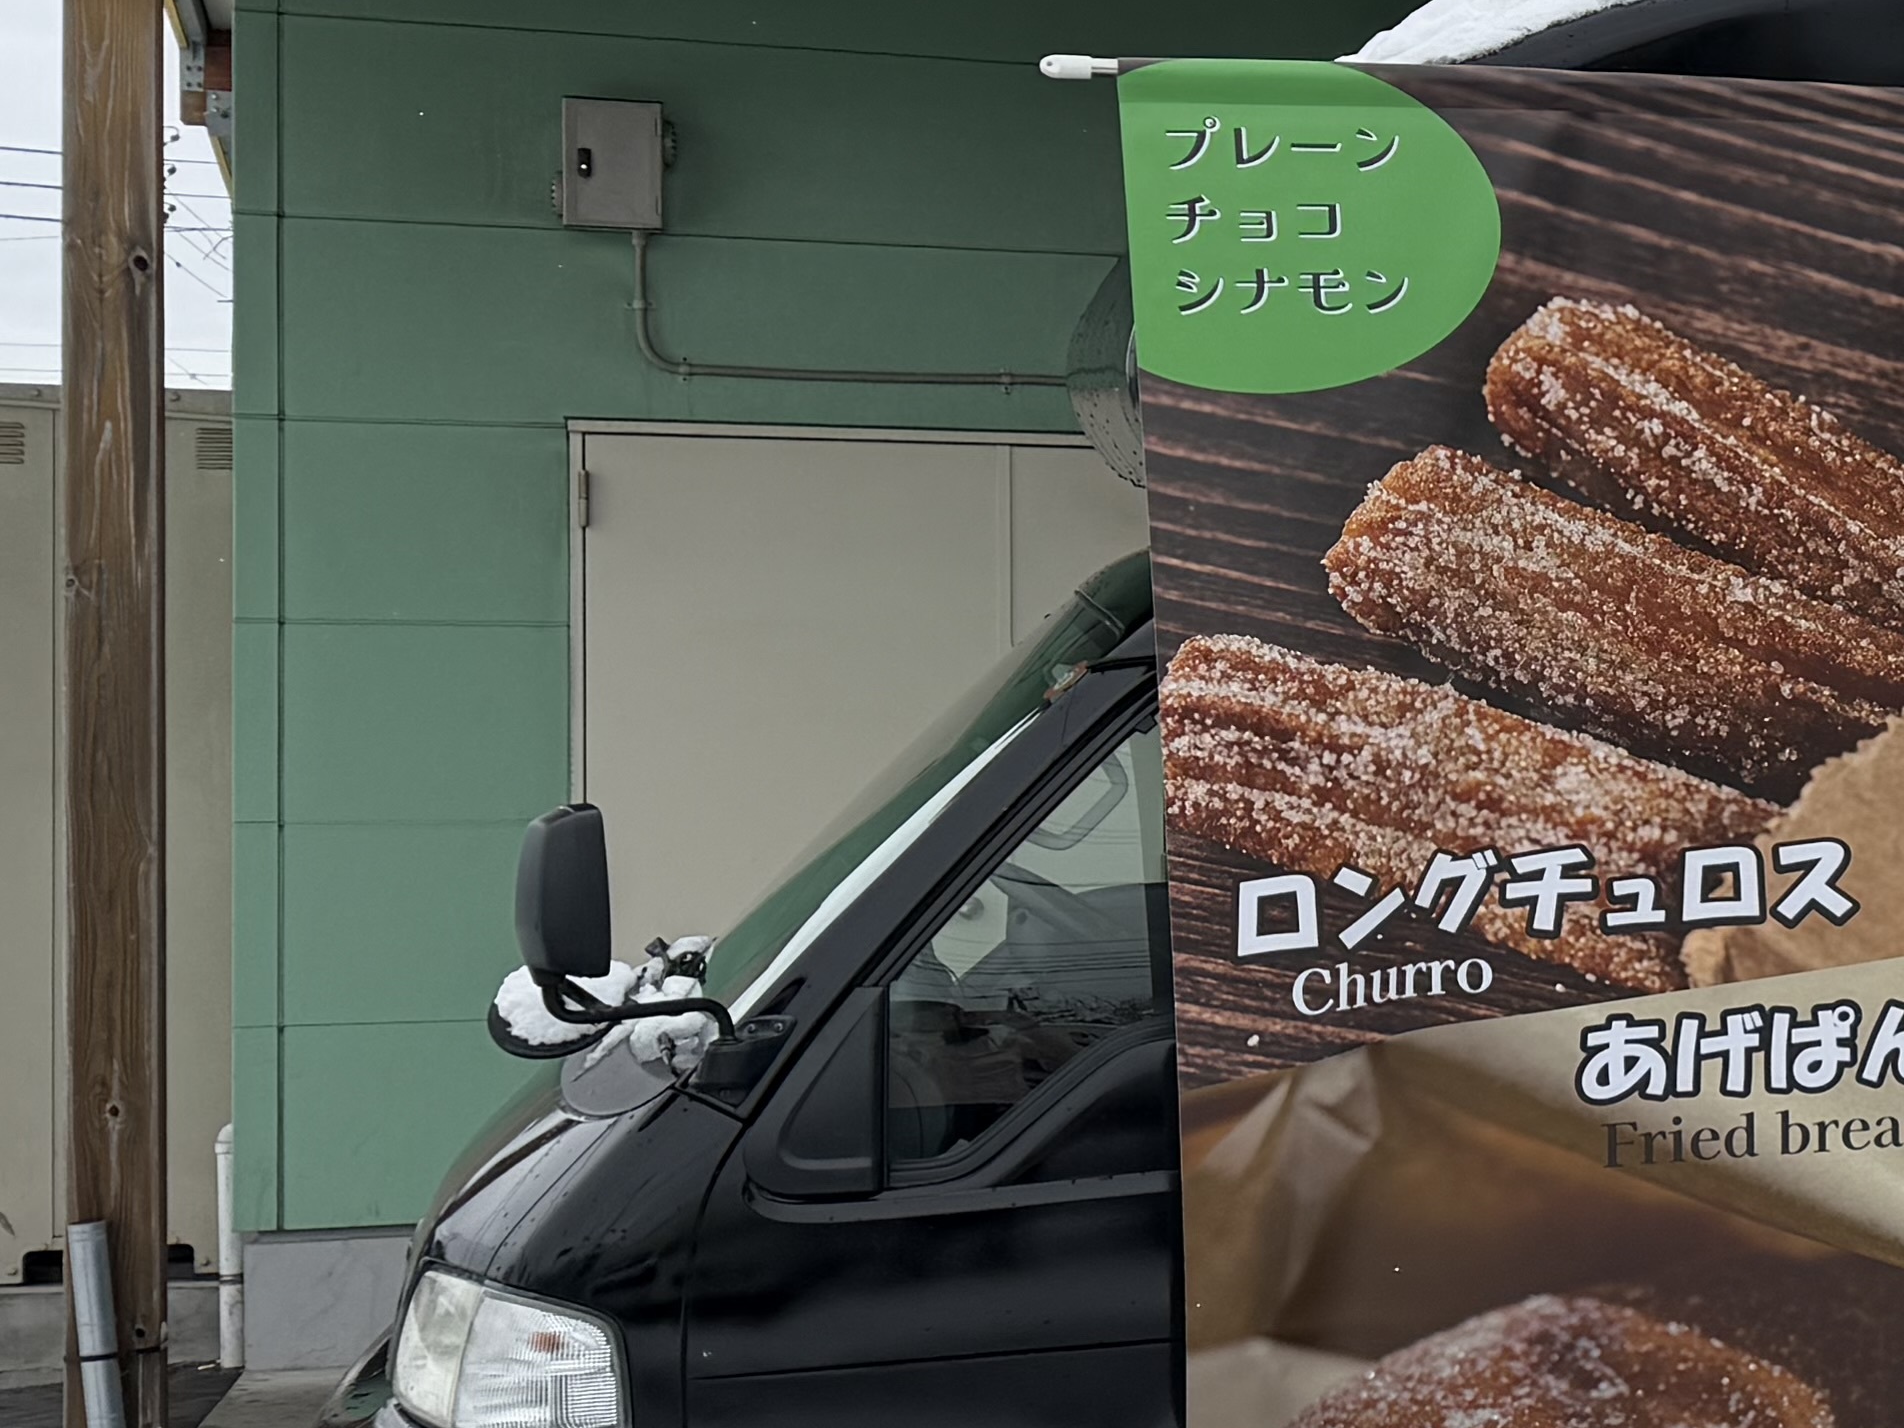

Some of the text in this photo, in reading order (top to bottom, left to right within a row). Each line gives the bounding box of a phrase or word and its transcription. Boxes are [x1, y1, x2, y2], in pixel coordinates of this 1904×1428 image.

[1165, 115, 1400, 172] プレーン
[1165, 194, 1342, 245] チョコ
[1175, 268, 1408, 315] シナモン
[1232, 838, 1860, 960] ロングチュロス
[1291, 954, 1494, 1017] Churro
[1602, 1112, 1759, 1170] Fried
